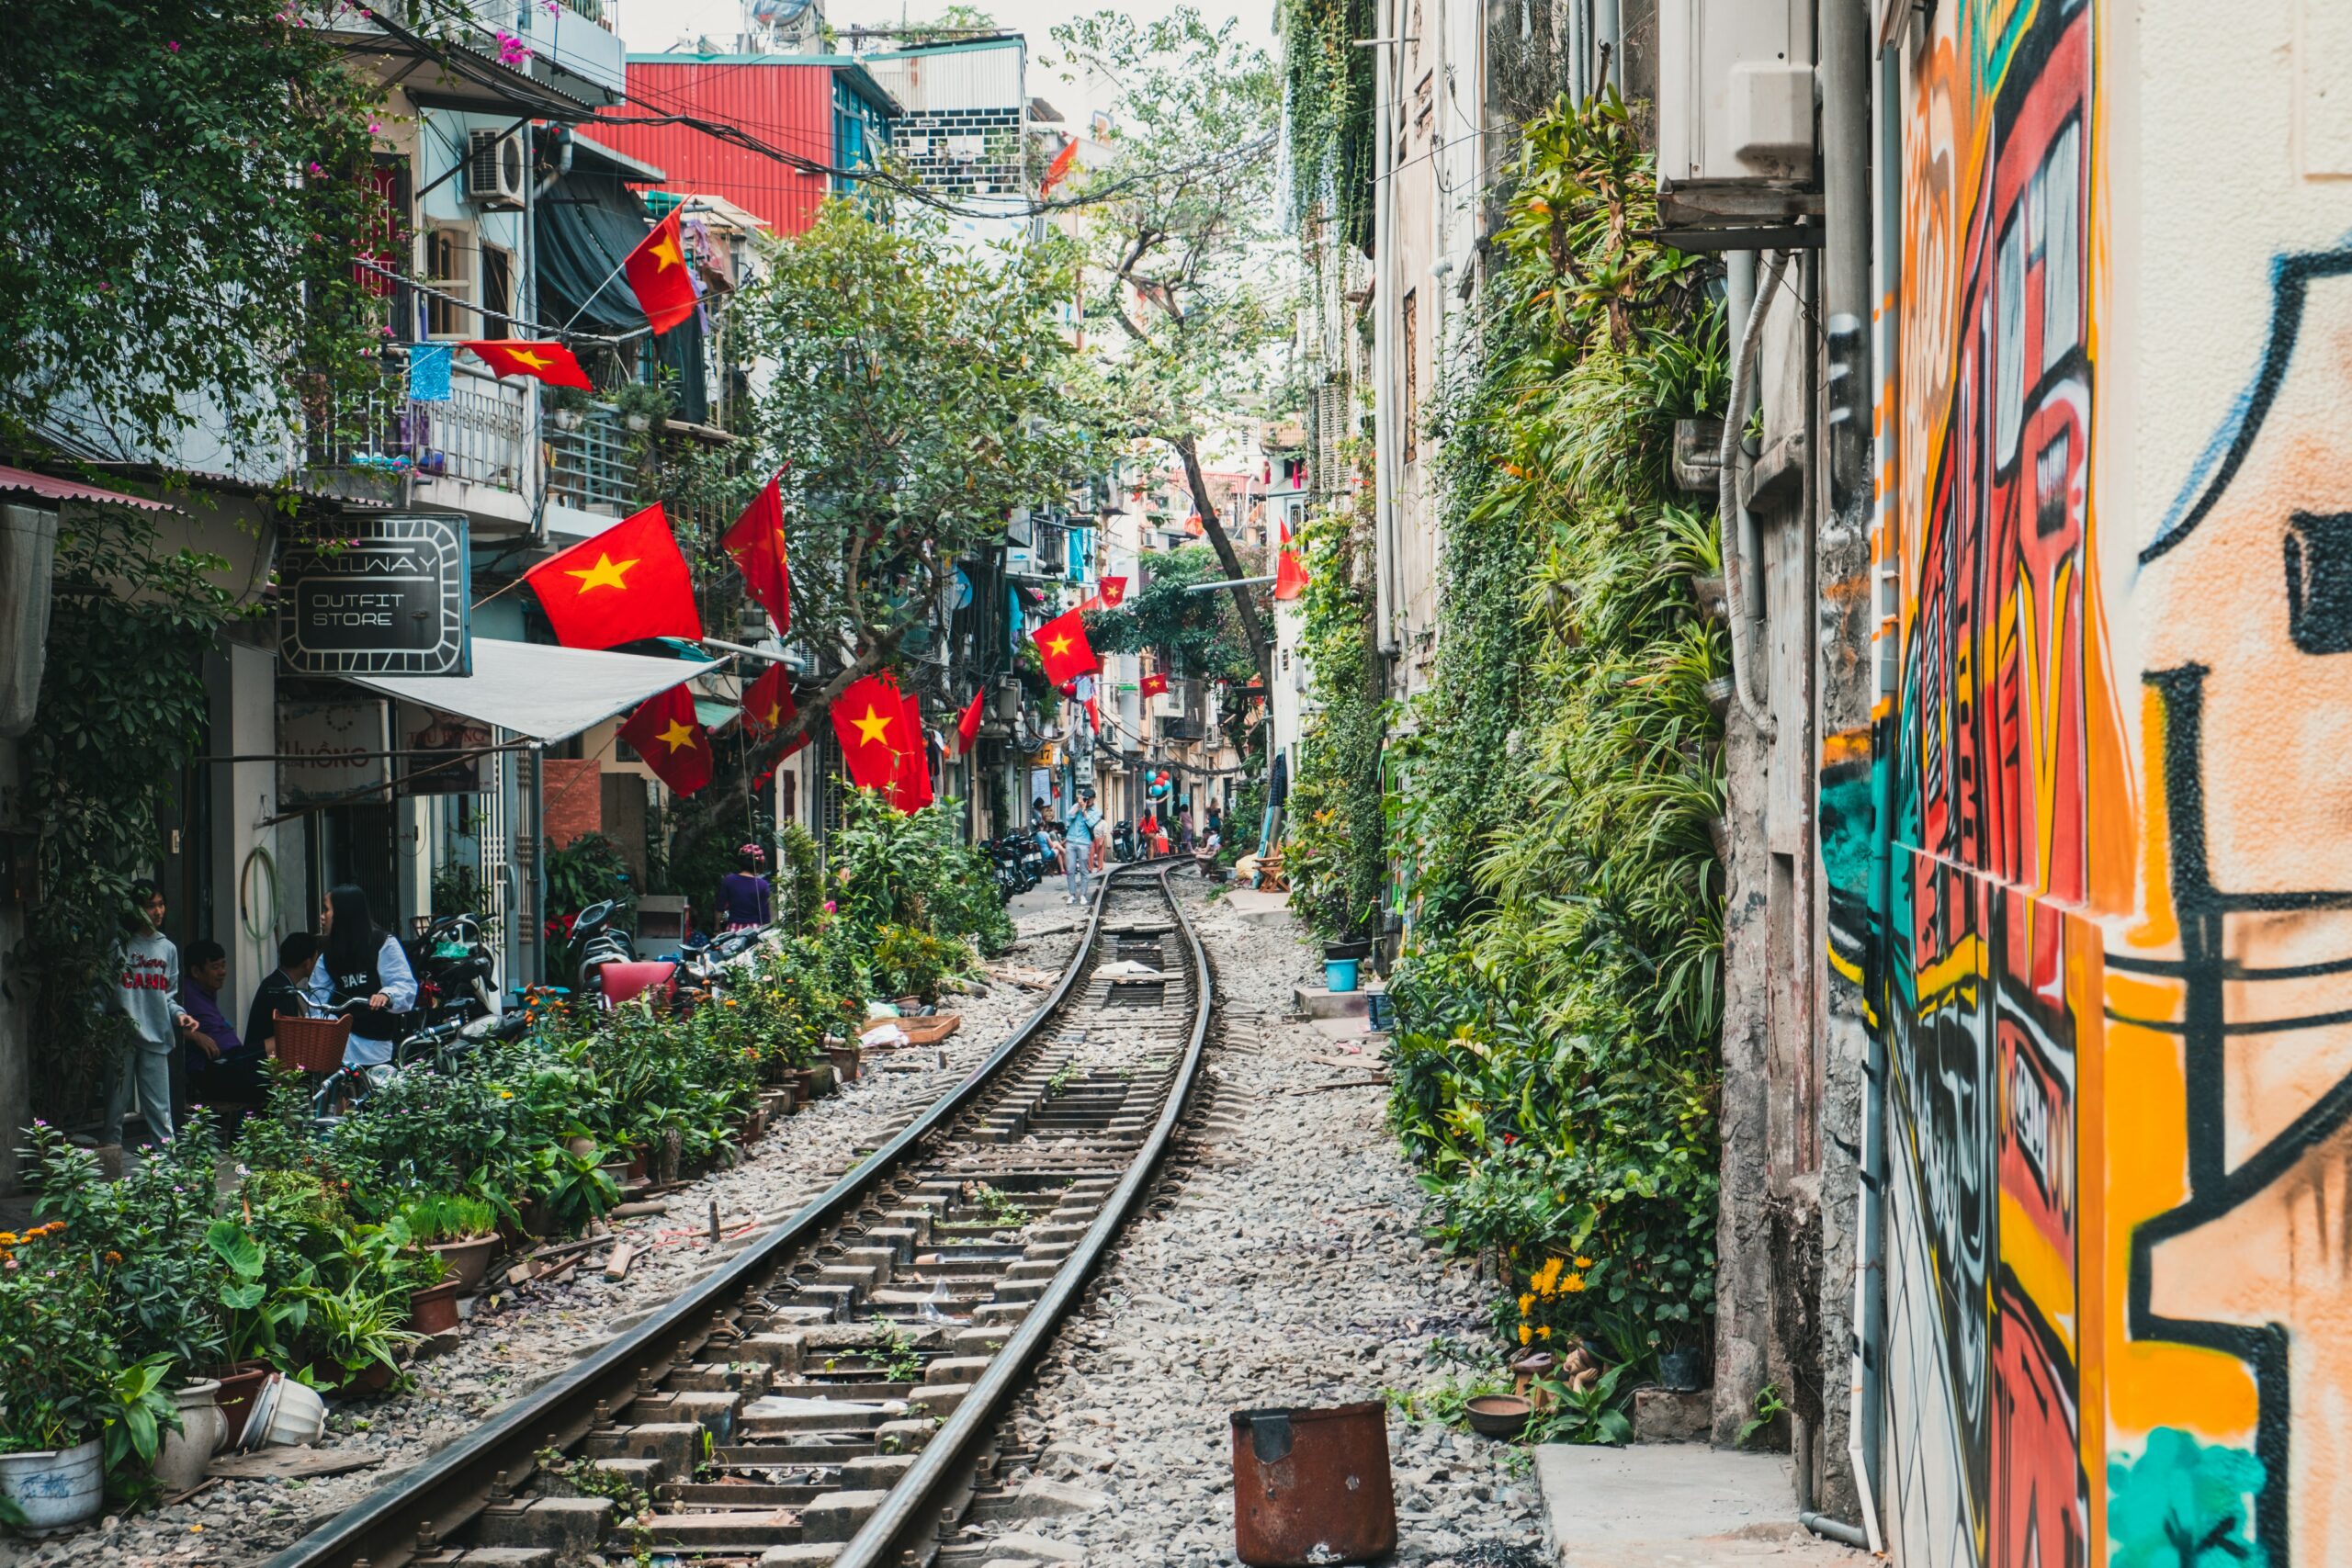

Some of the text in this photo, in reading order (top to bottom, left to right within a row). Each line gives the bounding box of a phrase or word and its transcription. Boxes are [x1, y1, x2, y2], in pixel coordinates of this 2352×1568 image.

[282, 556, 438, 572] RAILWAY
[312, 593, 405, 607] OUTFIT
[312, 612, 393, 626] STORE
